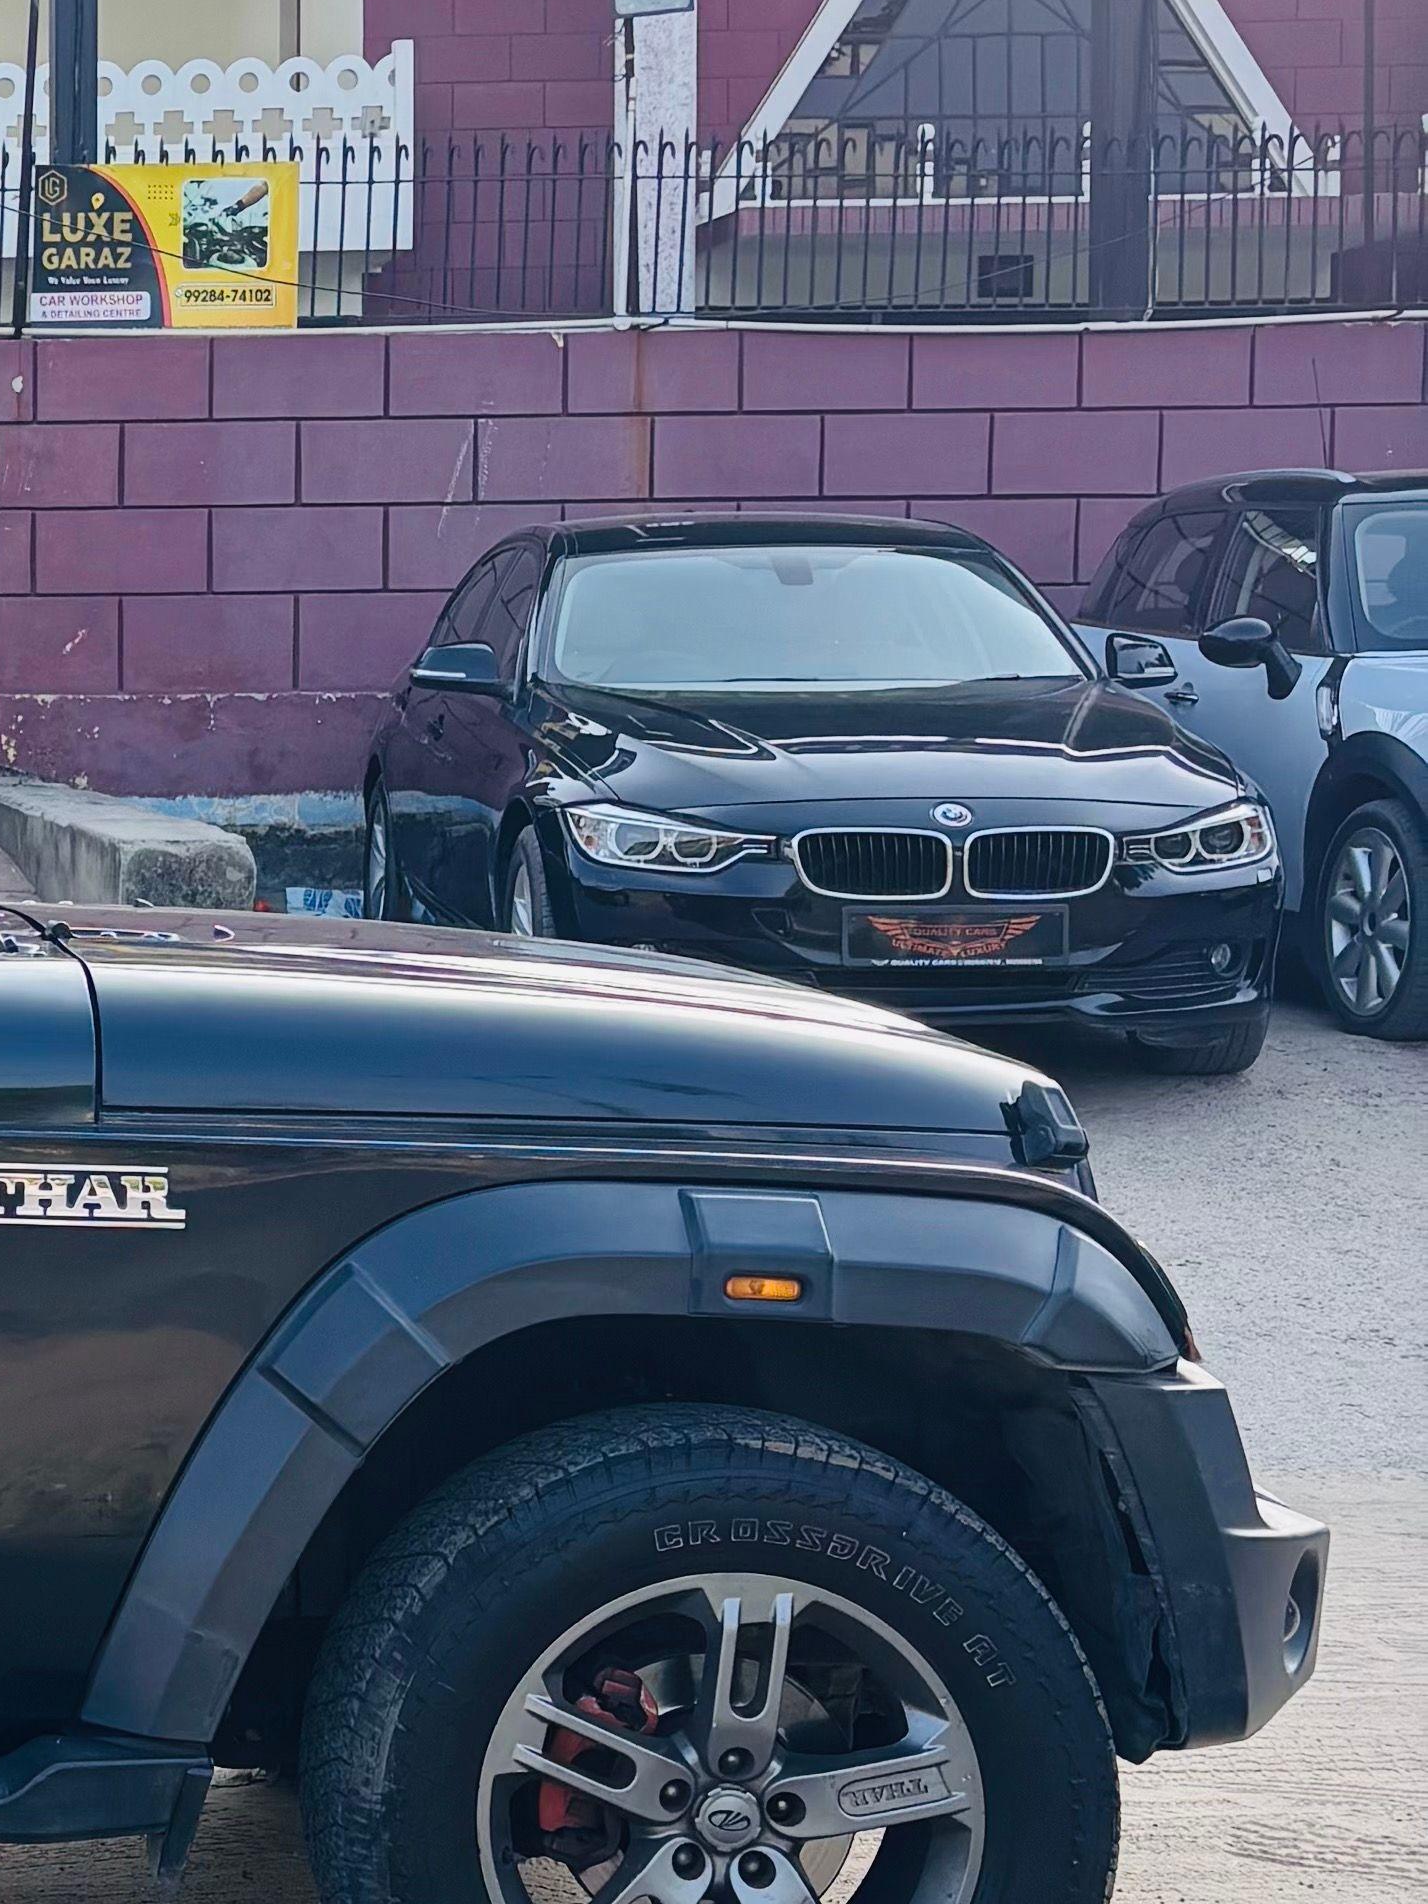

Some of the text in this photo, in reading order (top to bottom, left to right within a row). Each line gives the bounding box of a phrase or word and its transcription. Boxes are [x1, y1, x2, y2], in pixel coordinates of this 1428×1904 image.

[42, 211, 133, 242] LUXE
[42, 247, 132, 270] GARAZ
[40, 294, 143, 307] CAR WORKSHOP
[184, 288, 272, 304] 99284-74102
[50, 309, 100, 319] DETAILING
[102, 308, 142, 318] CENTRE
[654, 1518, 1018, 1688] CROSSDRIVE AT
[842, 1778, 929, 1807] THAR
